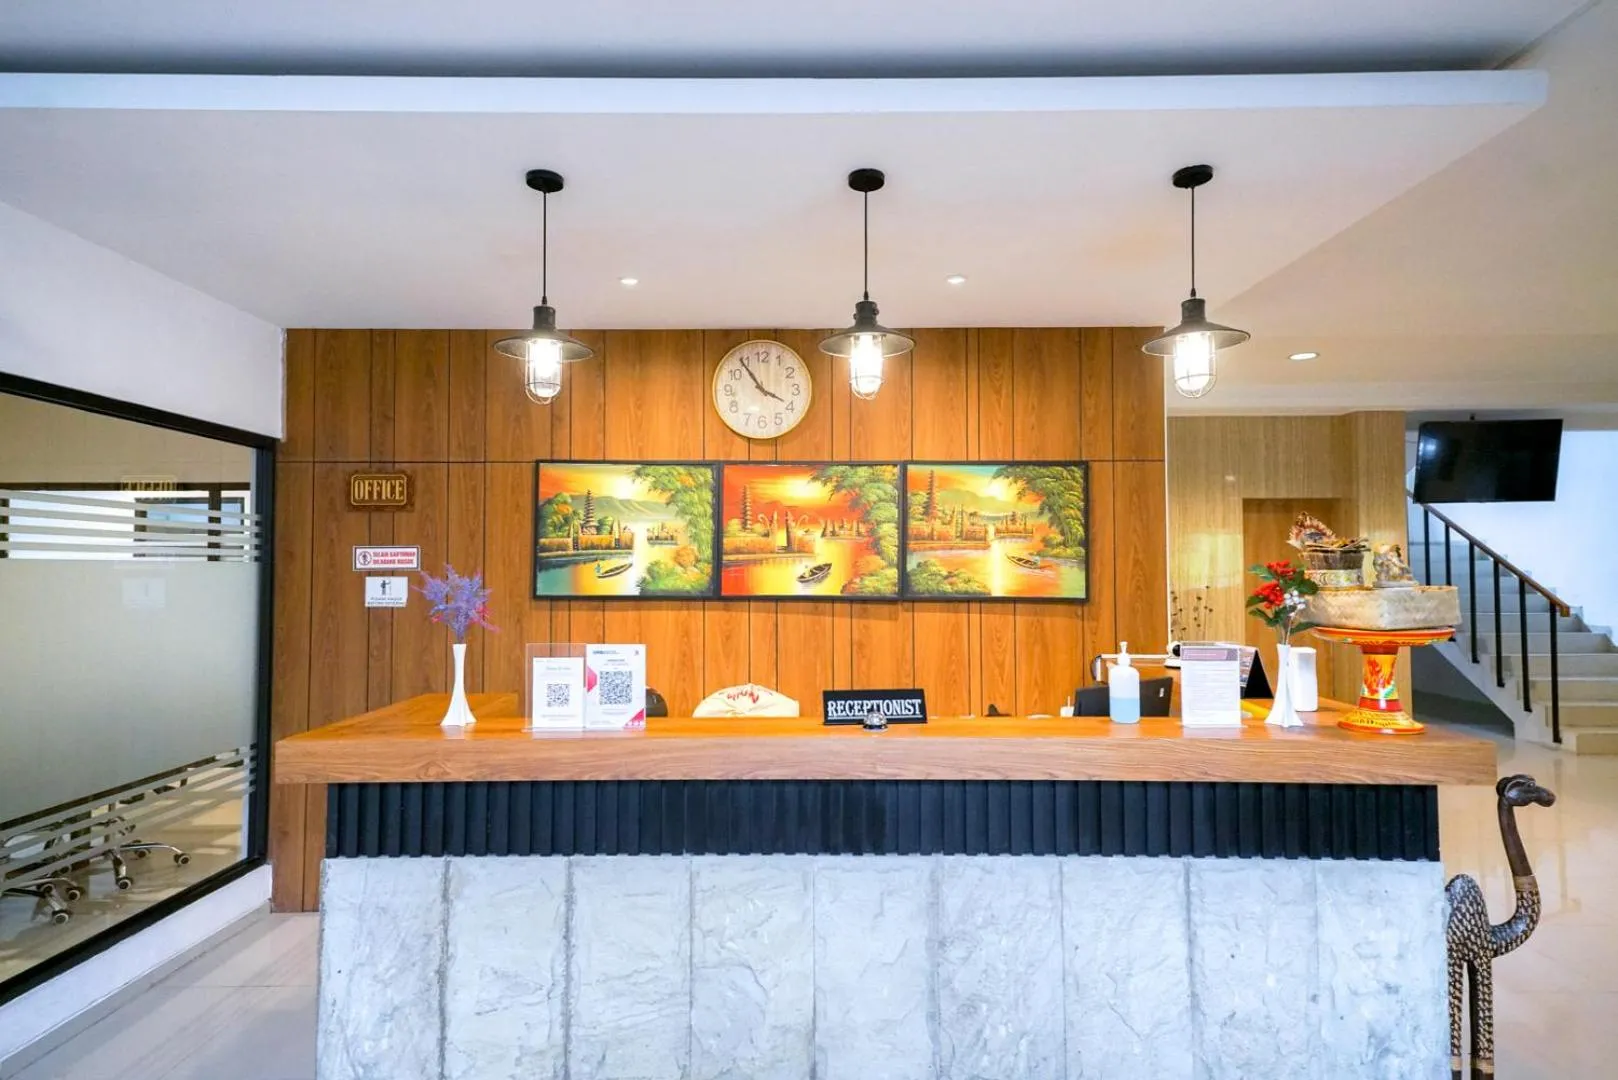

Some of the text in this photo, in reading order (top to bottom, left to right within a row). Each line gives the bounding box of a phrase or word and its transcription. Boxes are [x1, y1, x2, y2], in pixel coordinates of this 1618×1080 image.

[754, 350, 769, 363] 12
[776, 355, 781, 366] 1
[728, 368, 742, 380] 10
[785, 366, 795, 379] 2
[724, 384, 733, 396] 9
[791, 384, 800, 396] 3
[729, 400, 739, 413] 8
[785, 400, 794, 413] 4
[743, 412, 751, 426] 7
[757, 415, 767, 429] 6
[774, 412, 783, 426] 5
[354, 480, 404, 500] OFFICE
[827, 699, 921, 716] RECEPTIONIST
